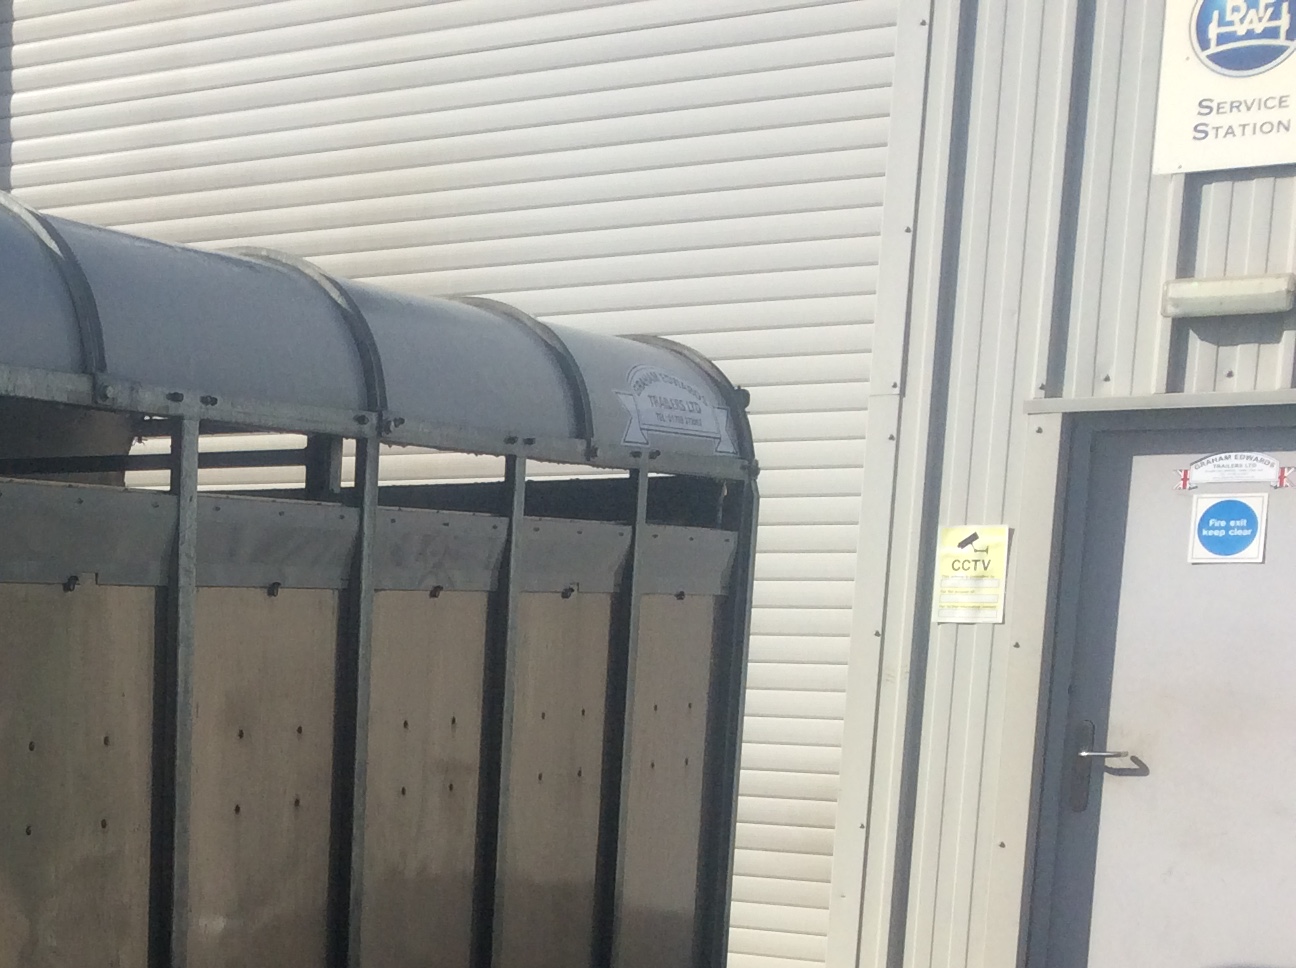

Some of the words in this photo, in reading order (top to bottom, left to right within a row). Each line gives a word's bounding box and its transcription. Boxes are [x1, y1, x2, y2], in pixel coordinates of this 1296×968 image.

[1197, 95, 1290, 116] SERVICE
[1192, 119, 1291, 141] STATION
[1194, 454, 1232, 470] GRAHAM
[1234, 454, 1276, 468] EDWARDS
[1209, 519, 1226, 527] Fire
[1229, 518, 1247, 527] exit
[1202, 528, 1225, 537] keep
[1228, 528, 1253, 536] clear
[951, 559, 991, 572] CCTV
